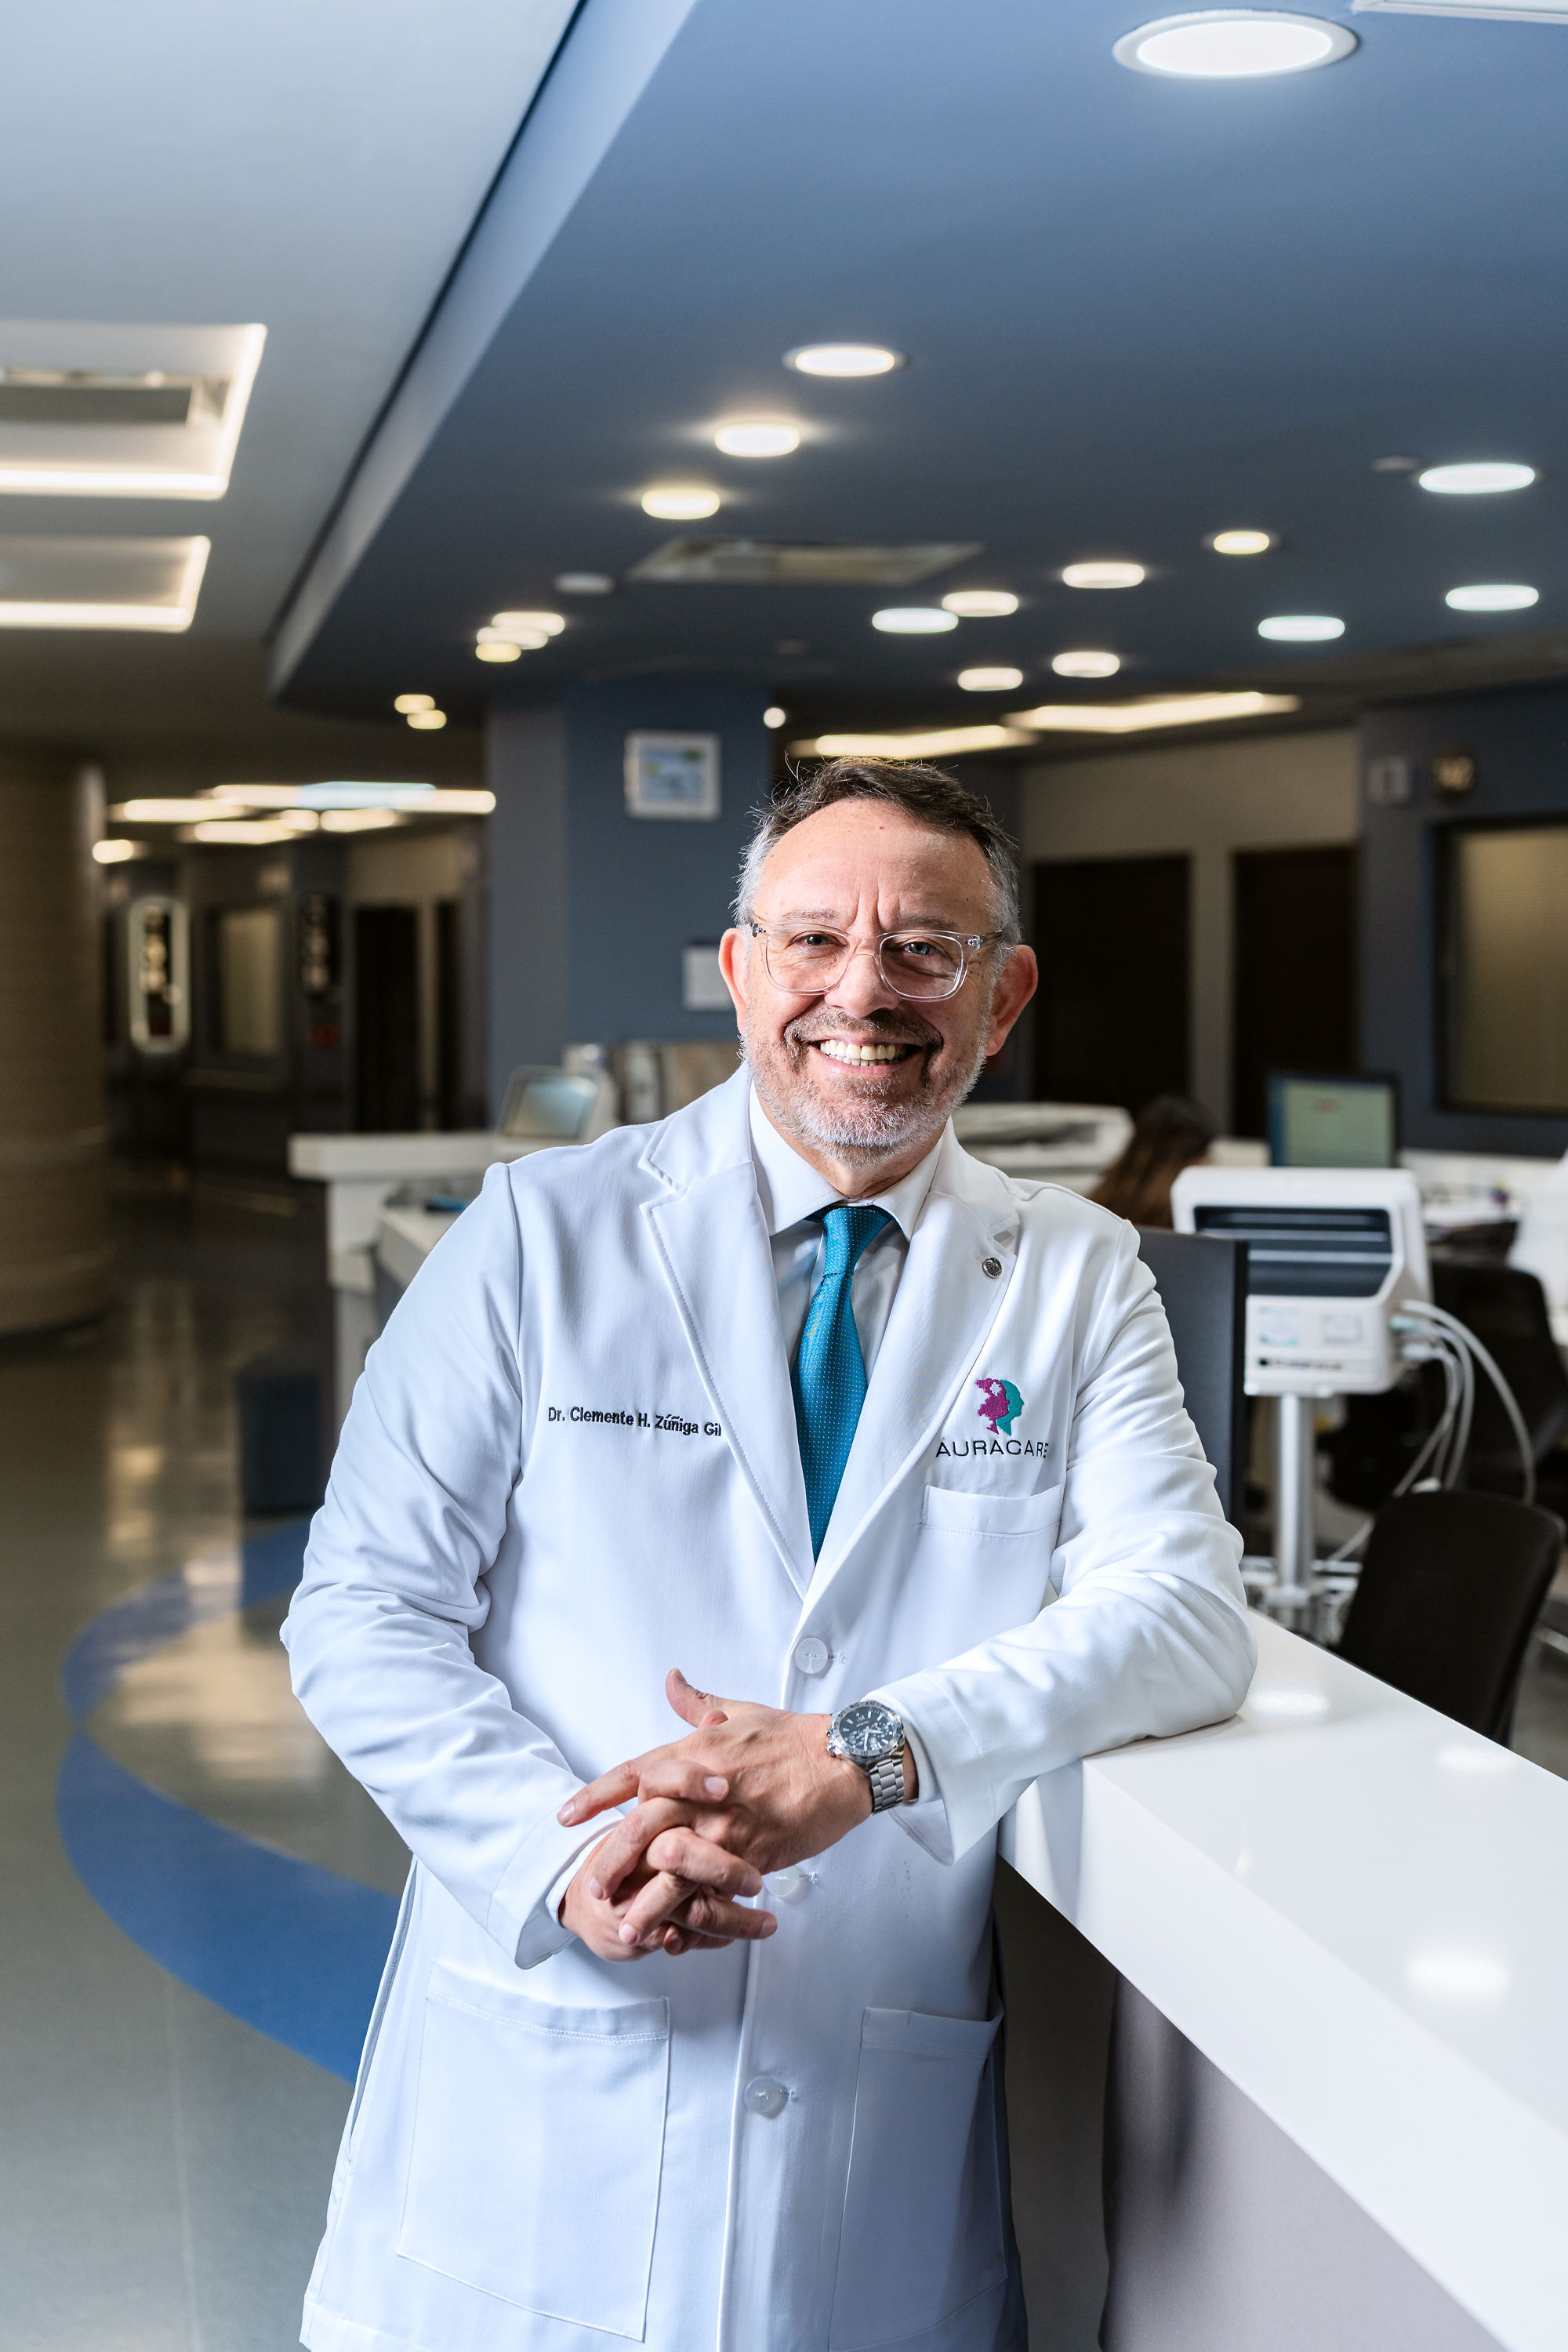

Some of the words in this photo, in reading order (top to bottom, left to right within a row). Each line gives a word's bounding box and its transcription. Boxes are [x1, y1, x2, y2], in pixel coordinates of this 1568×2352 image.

[548, 1406, 565, 1422] Dr.
[569, 1406, 634, 1426] Clemente
[637, 1412, 651, 1428] H.
[655, 1414, 699, 1436] Zúñiga
[703, 1421, 722, 1436] Gil
[935, 1439, 1049, 1458] AURACARE
